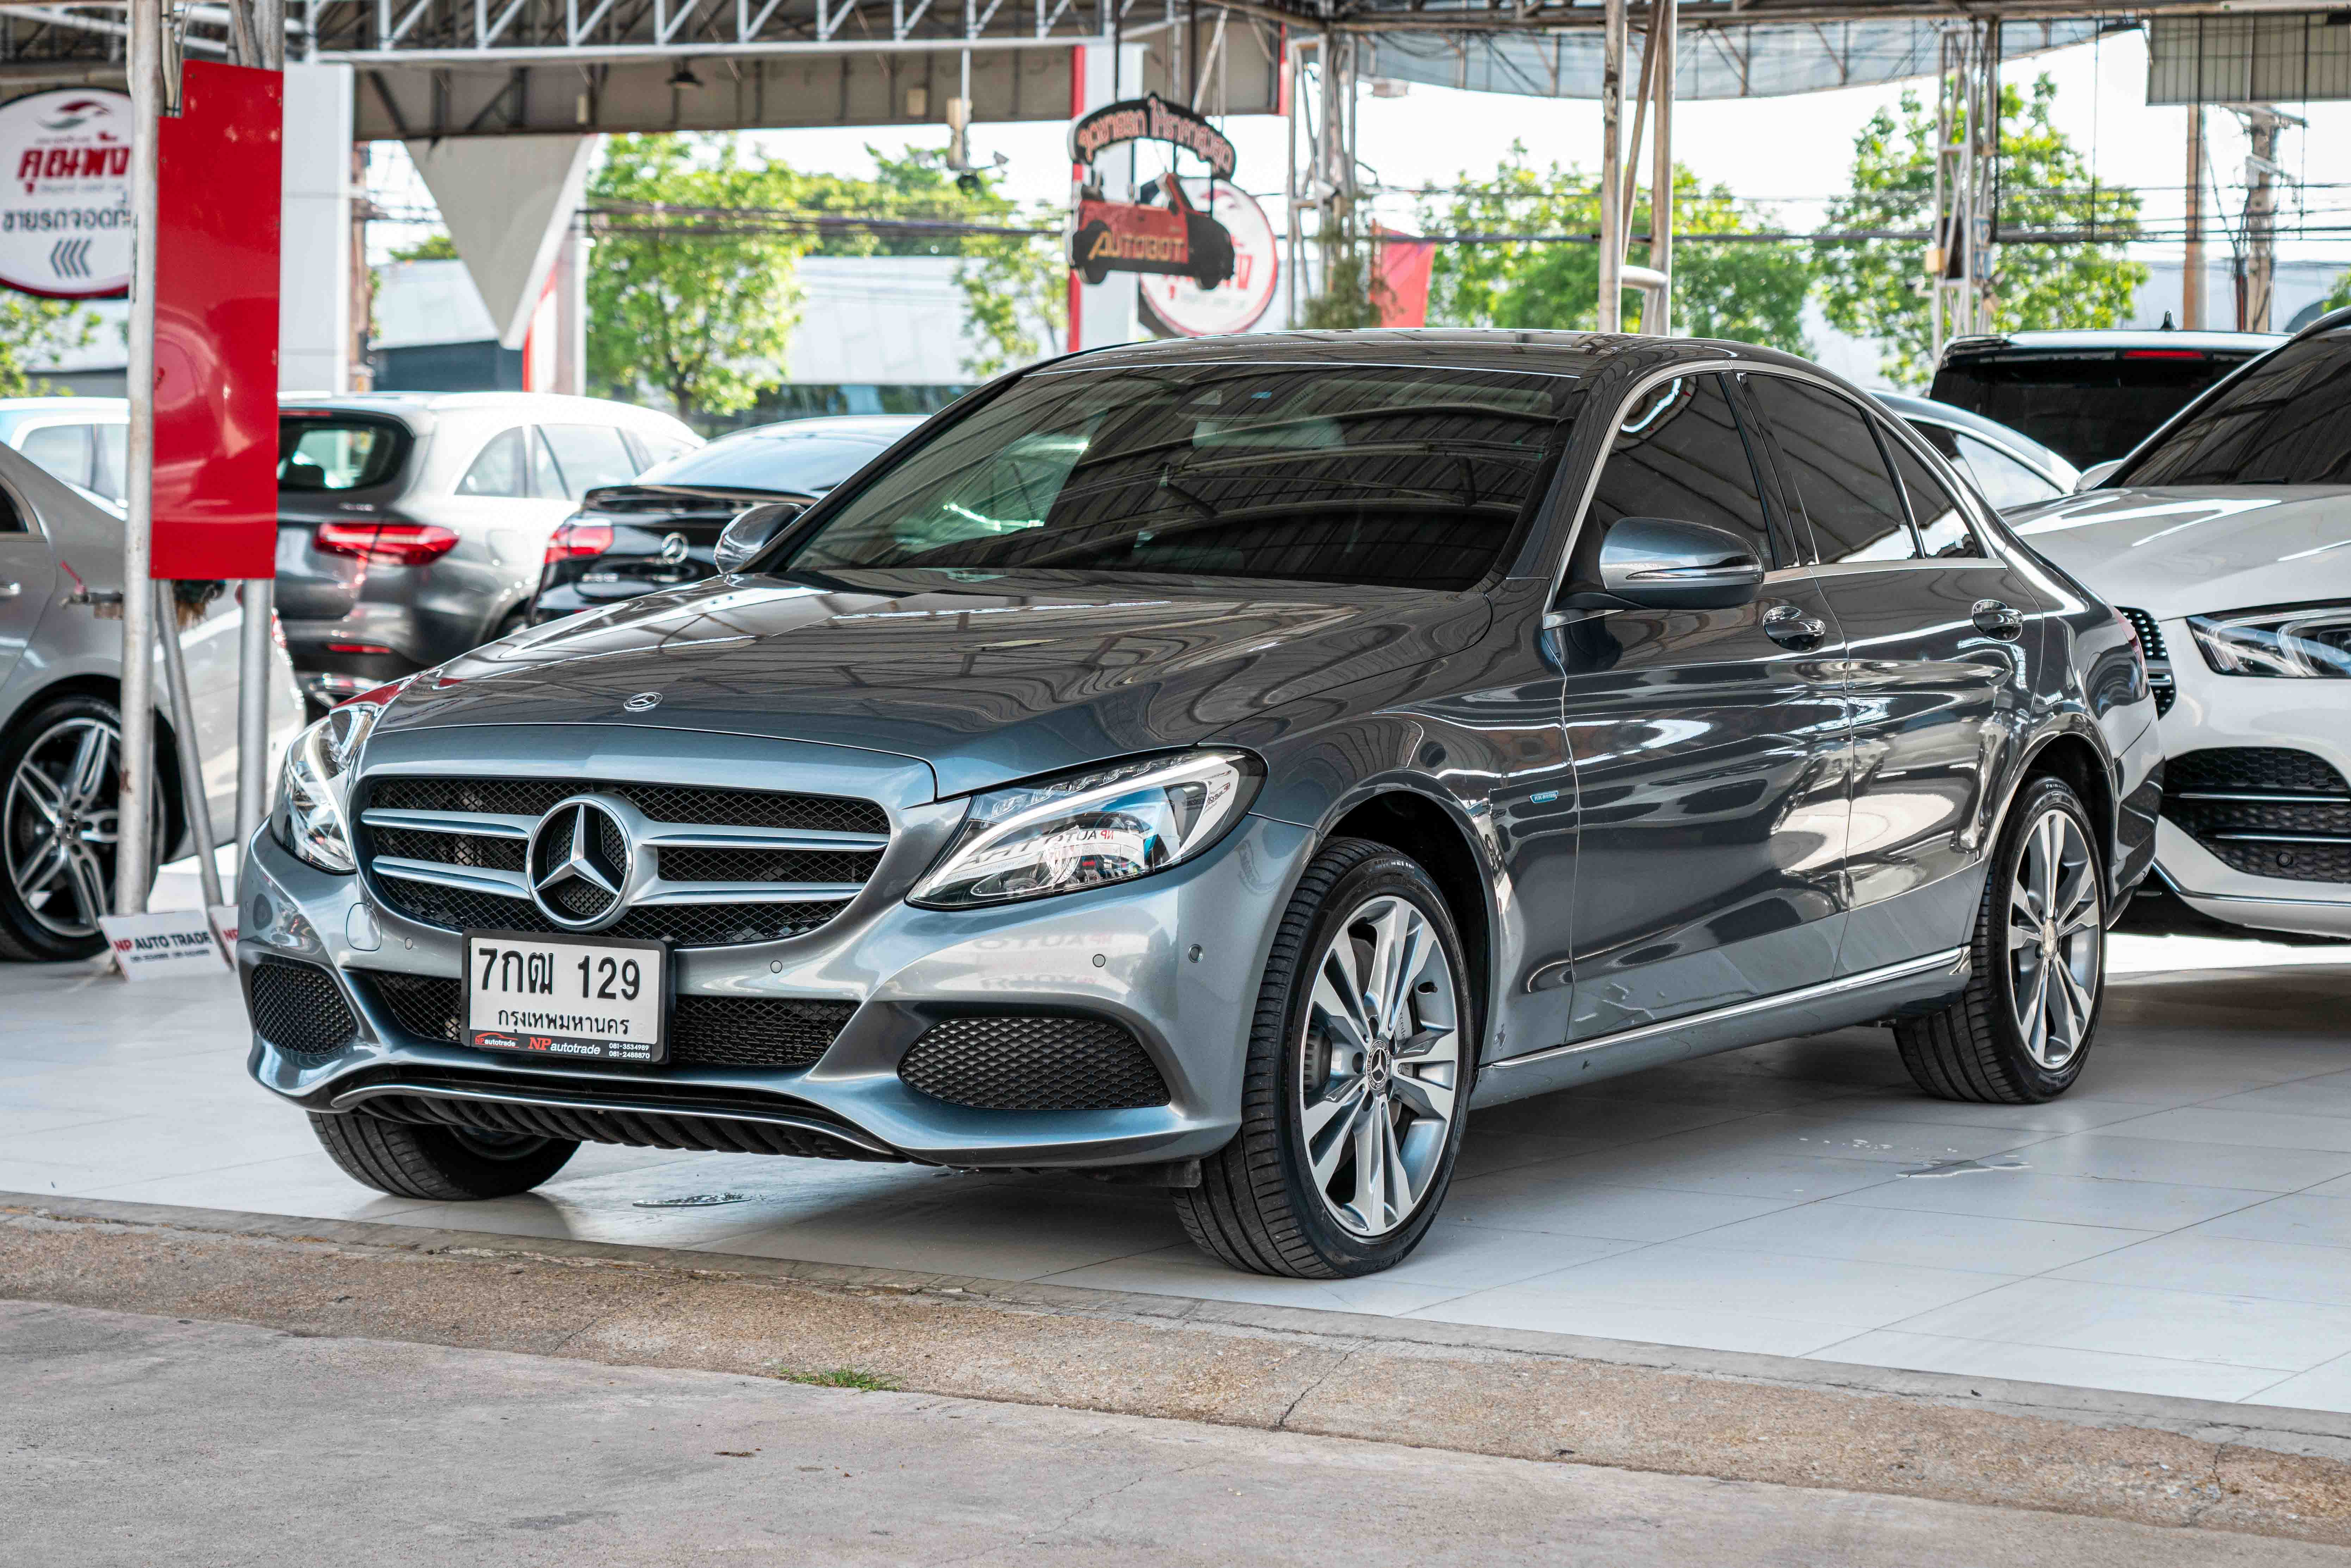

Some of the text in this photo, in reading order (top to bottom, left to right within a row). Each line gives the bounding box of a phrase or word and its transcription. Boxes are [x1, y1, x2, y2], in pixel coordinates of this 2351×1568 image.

[114, 939, 132, 952] NP
[135, 935, 169, 950] AUTO
[577, 955, 640, 1001] 129
[498, 1009, 630, 1035] กรุงเทพมหานคร
[528, 1037, 601, 1055] NP autotrade
[609, 1043, 649, 1051] 081-3534989
[609, 1050, 650, 1059] 081-2488870
